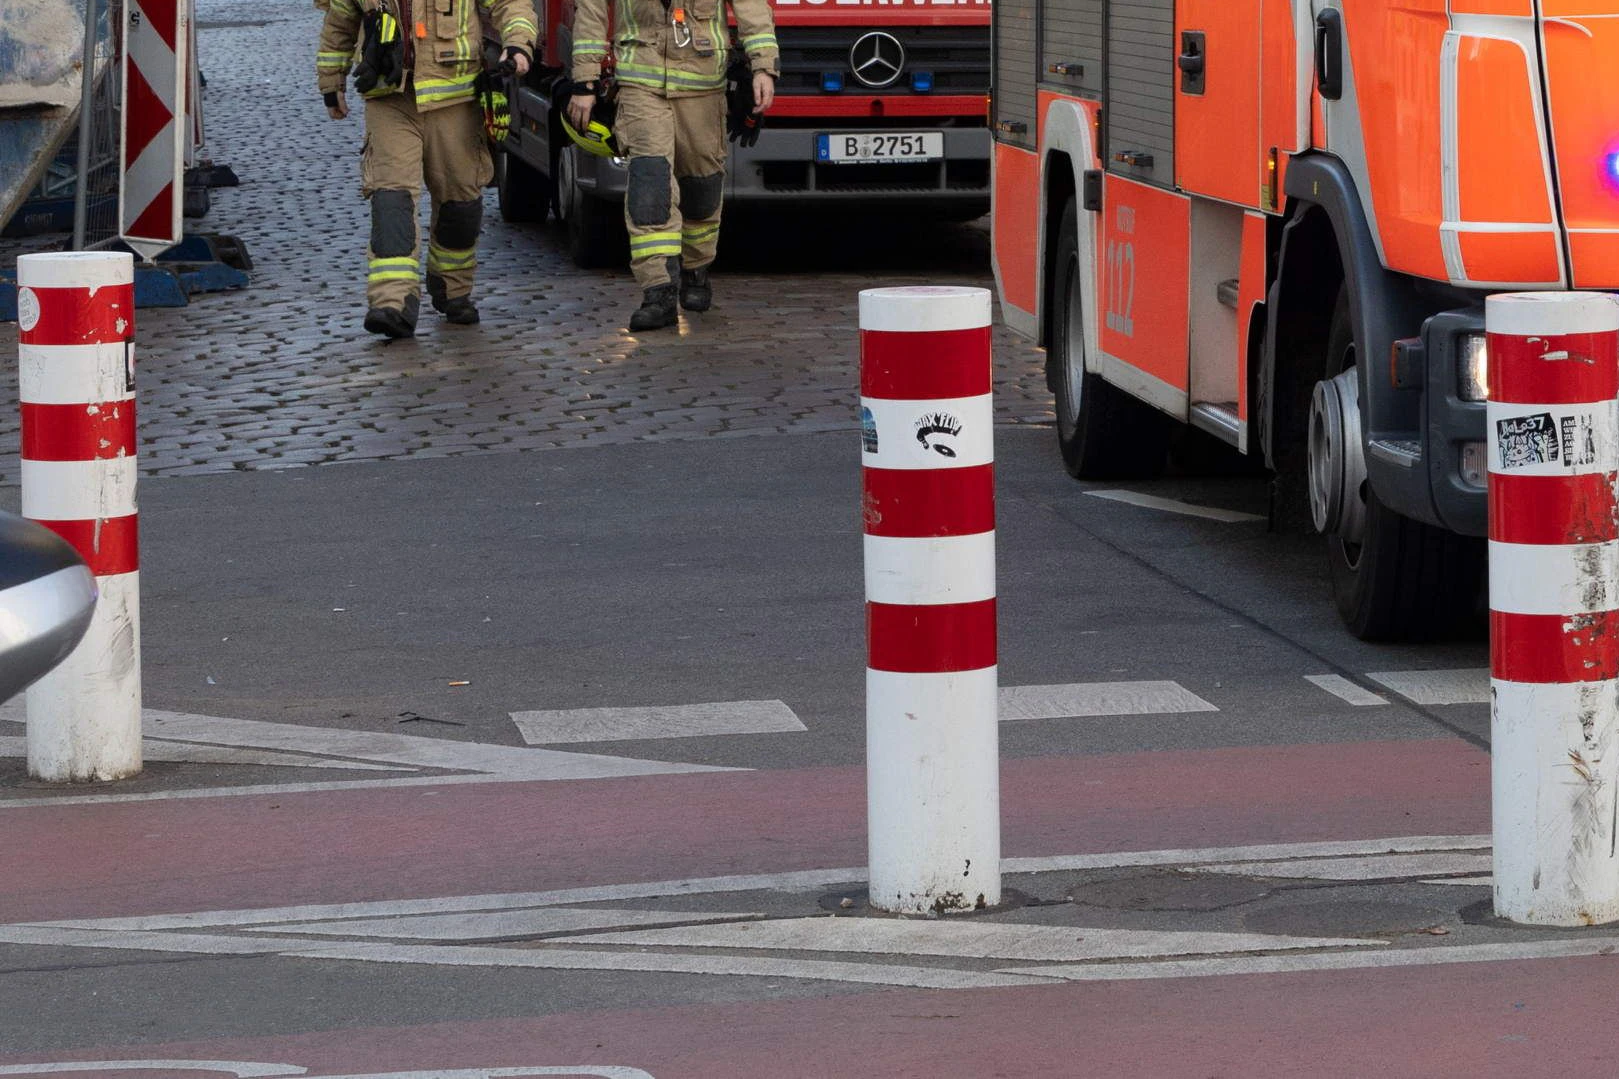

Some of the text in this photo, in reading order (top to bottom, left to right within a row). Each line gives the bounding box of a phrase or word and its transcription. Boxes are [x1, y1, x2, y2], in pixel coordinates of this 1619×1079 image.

[845, 136, 858, 156] B
[873, 135, 926, 156] 2751
[1106, 239, 1135, 338] 112
